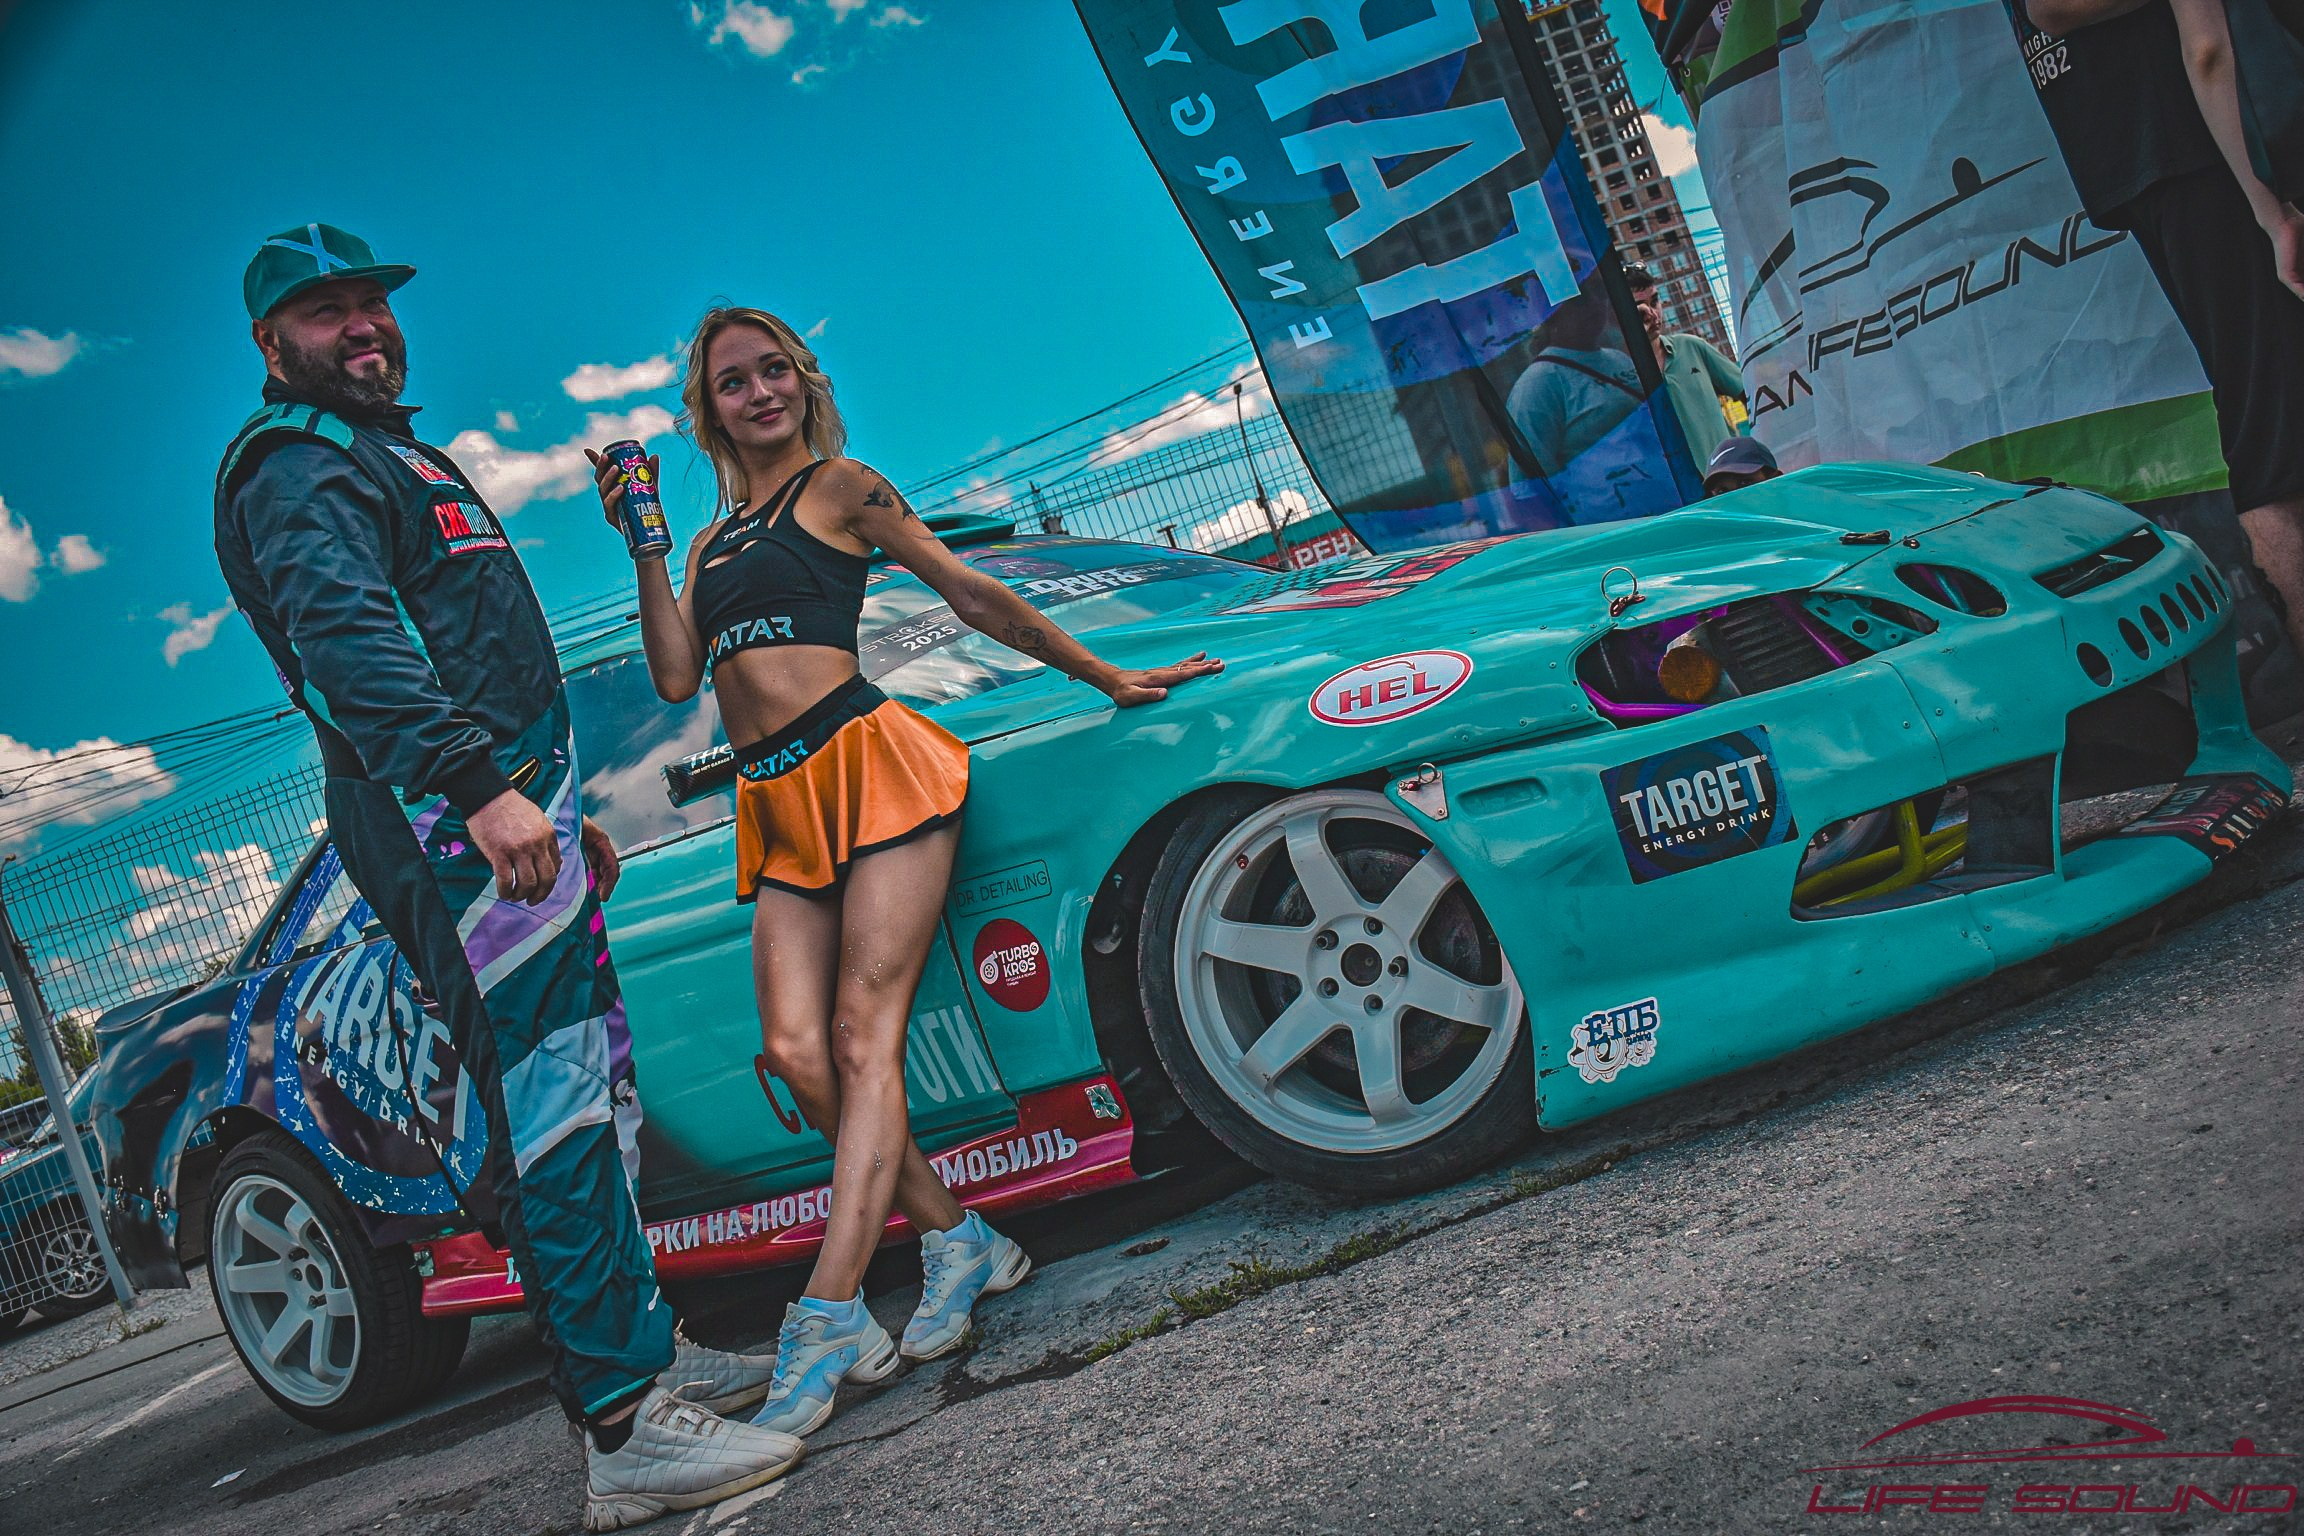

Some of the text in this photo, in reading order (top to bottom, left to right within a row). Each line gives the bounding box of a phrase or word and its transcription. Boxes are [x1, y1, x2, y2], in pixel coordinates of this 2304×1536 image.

[2031, 46, 2072, 90] 1982
[1808, 208, 2129, 374] IFESOUND
[723, 518, 761, 542] TEAM
[1025, 567, 1122, 594] DRIFT
[902, 625, 958, 652] 2025
[1338, 671, 1442, 715] HEL
[1642, 808, 1771, 854] ENERGY DRINK
[979, 870, 1049, 902] DETAILING
[998, 940, 1041, 965] TURBO
[1003, 956, 1037, 978] KROS
[294, 919, 471, 1142] TARGET
[281, 1020, 463, 1175] ENERGY DRINK
[646, 1217, 700, 1257] РКИ
[707, 1209, 746, 1245] НА
[750, 1186, 833, 1235] ЛЮБО
